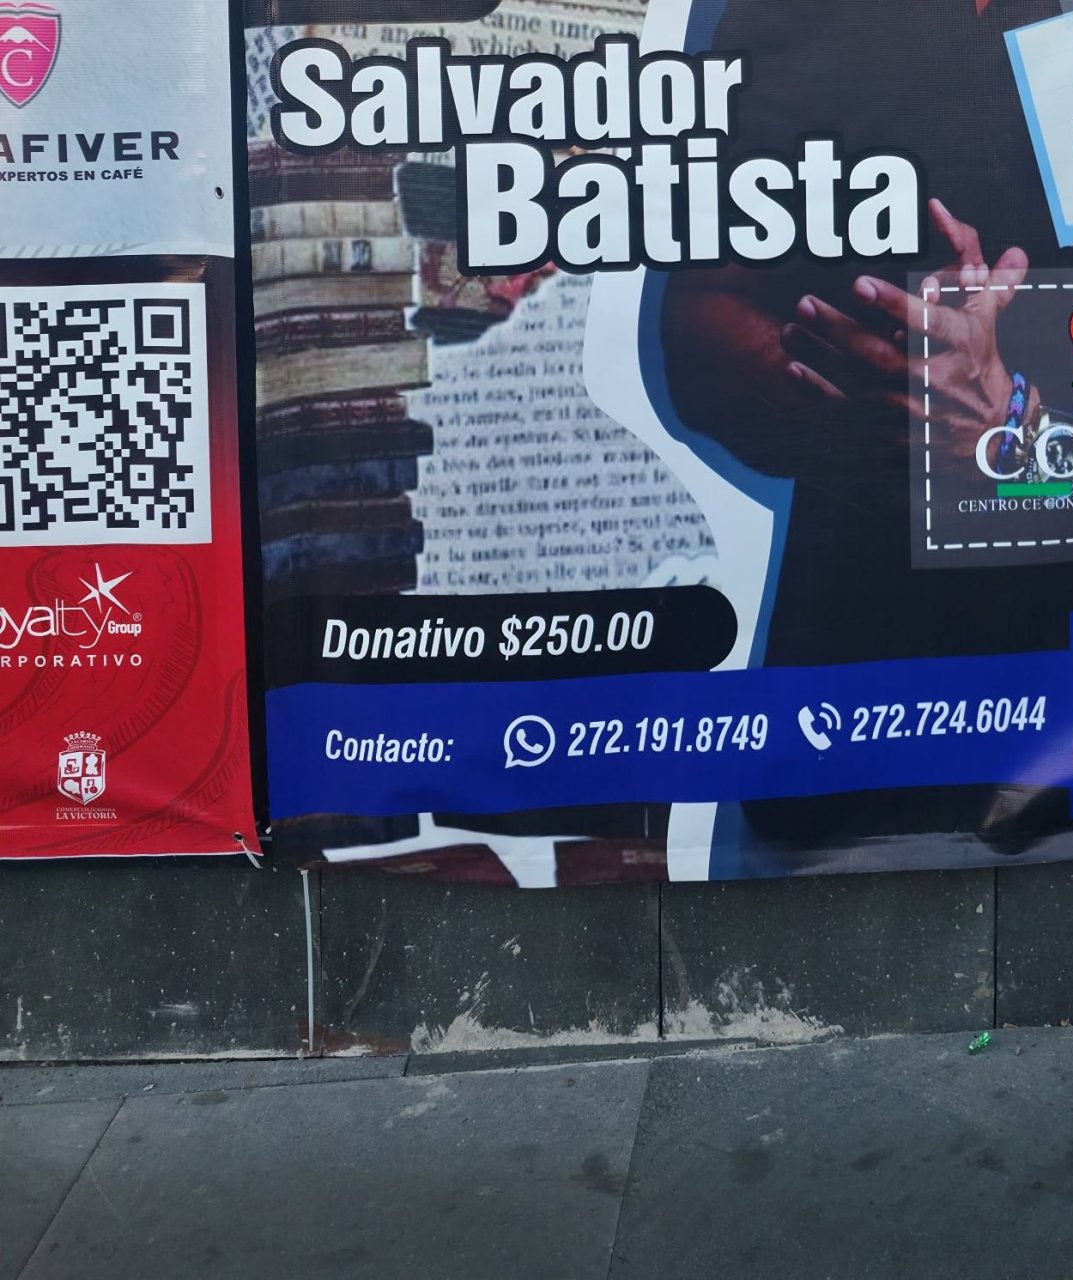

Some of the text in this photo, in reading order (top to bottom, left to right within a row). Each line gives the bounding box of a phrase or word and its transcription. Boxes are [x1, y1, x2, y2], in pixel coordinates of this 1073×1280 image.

[1, 49, 33, 87] C
[280, 43, 742, 146] Salvador
[74, 170, 95, 181] EN
[101, 166, 143, 180] CAFÉ
[466, 139, 920, 268] Batista
[958, 499, 1019, 513] CENTRO
[108, 621, 142, 637] Group
[322, 610, 654, 661] Donativo $250.00
[1, 654, 142, 668] RPORATIVO
[325, 696, 1047, 763] Contacto: 272.191.8749 272.724.6044
[56, 812, 117, 820] LA VICTORIA
